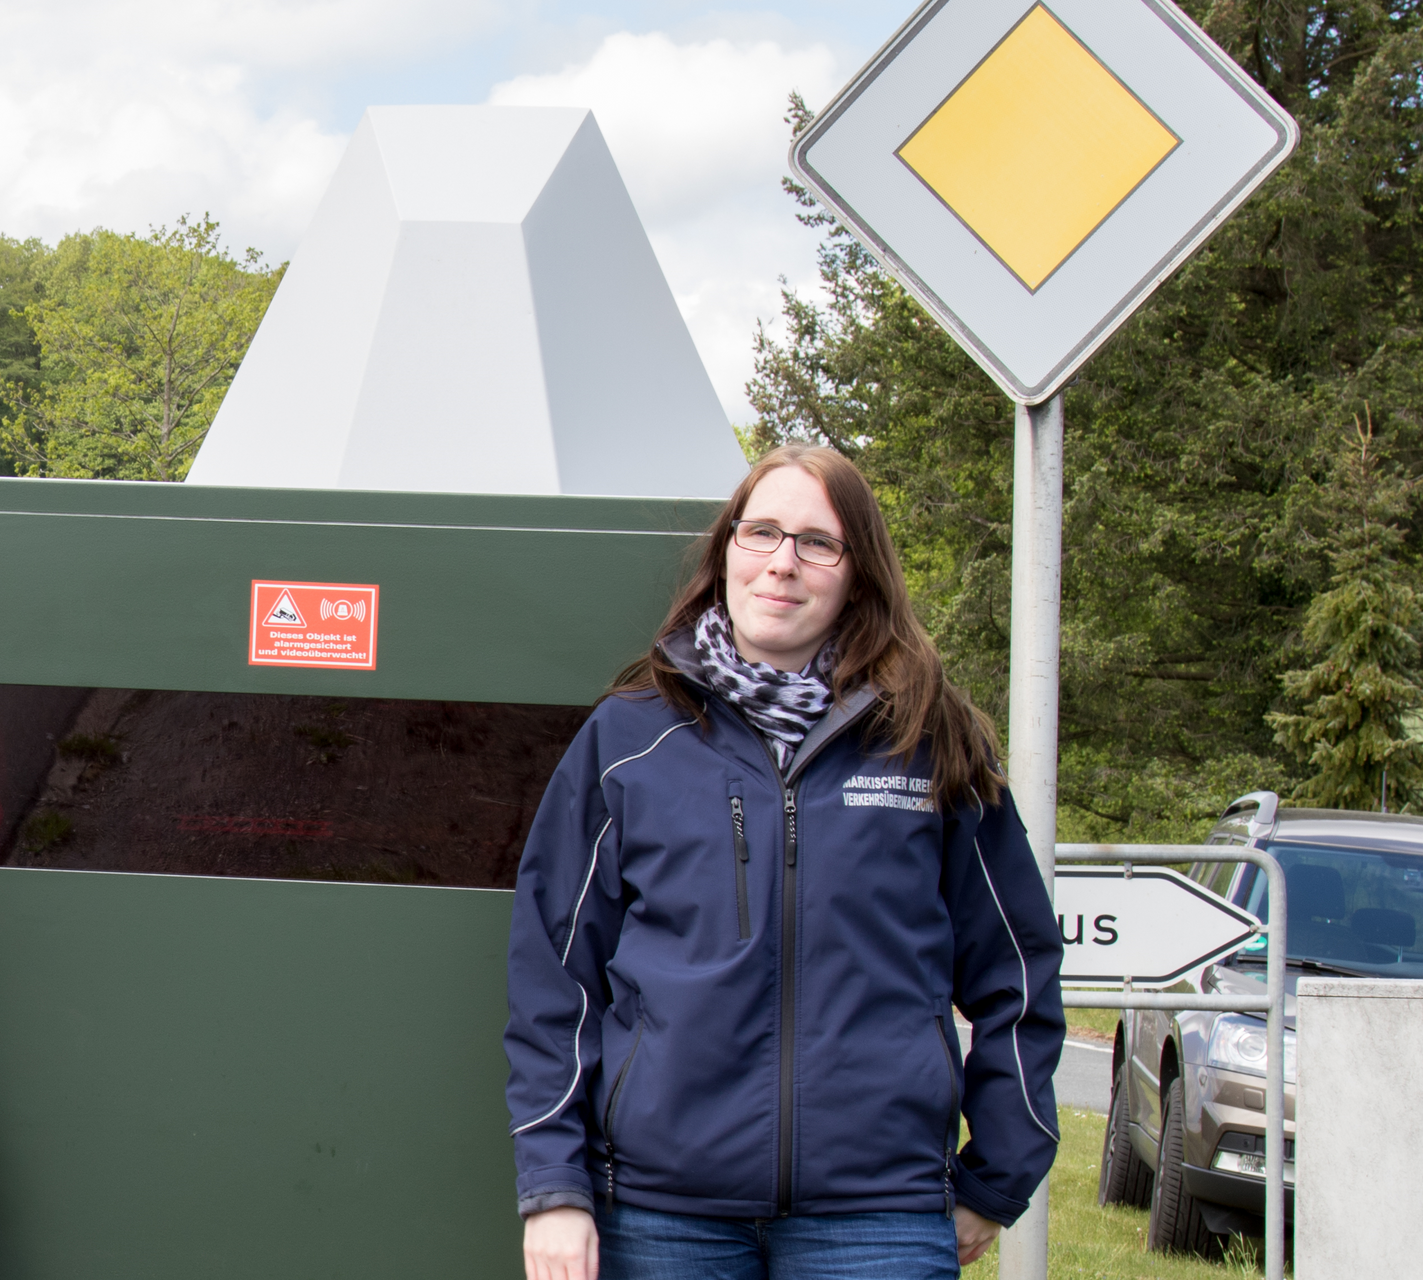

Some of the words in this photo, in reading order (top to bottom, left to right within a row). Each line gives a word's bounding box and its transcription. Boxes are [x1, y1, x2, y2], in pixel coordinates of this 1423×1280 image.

[270, 631, 304, 640] Dieses
[306, 632, 341, 642] Objekt
[343, 634, 357, 642] ist
[274, 640, 352, 650] alarmgesichert
[280, 649, 367, 660] videoüberwacht!
